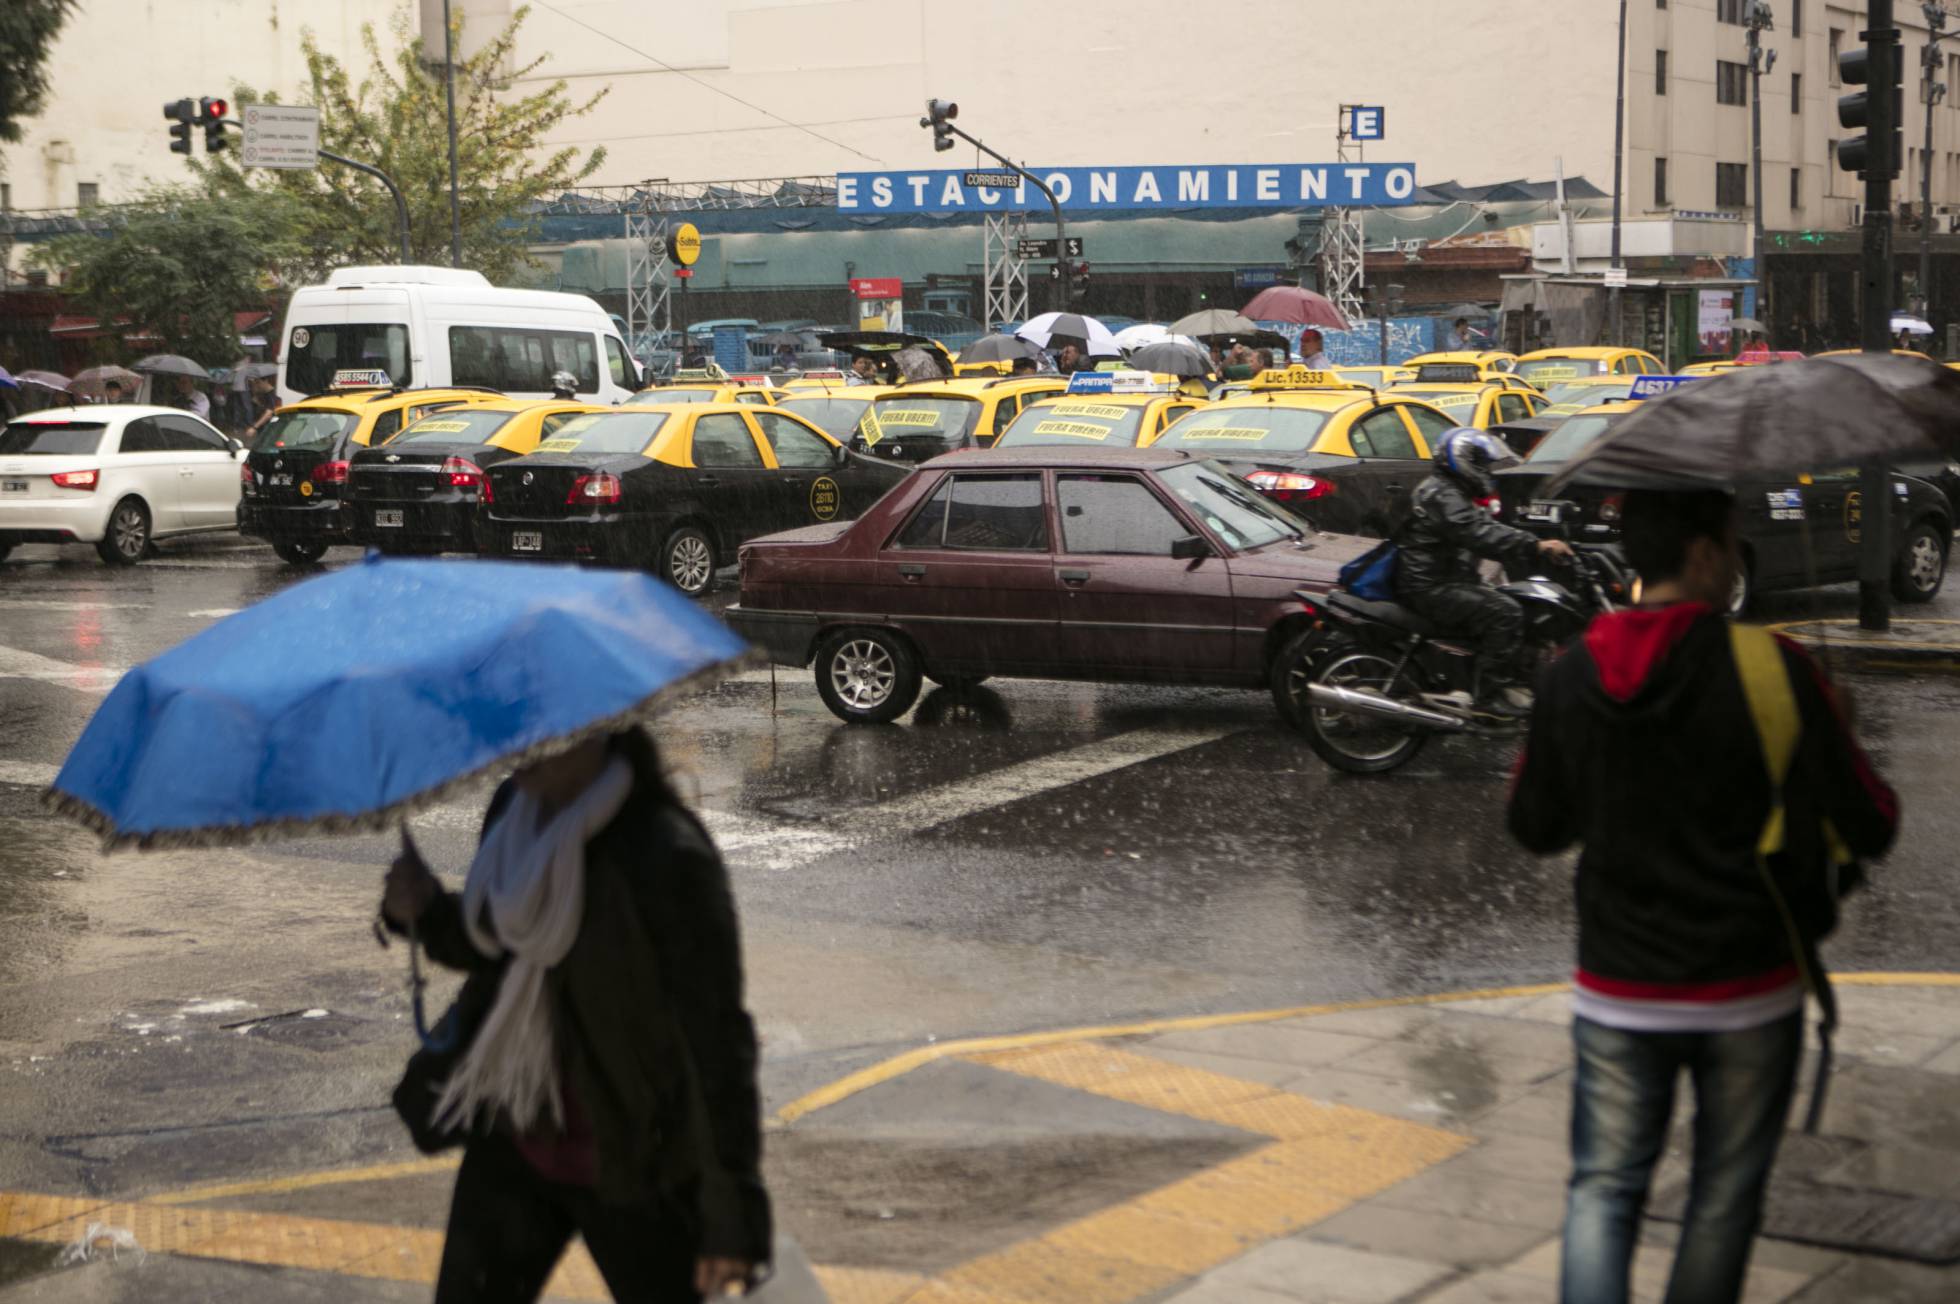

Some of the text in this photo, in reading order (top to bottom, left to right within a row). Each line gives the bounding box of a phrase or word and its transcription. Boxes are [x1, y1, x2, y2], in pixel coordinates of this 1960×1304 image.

[1356, 111, 1378, 136] E
[838, 168, 1413, 208] ESTACIONAMIENTO
[967, 174, 1018, 187] CORRIENTES
[294, 332, 307, 344] 90
